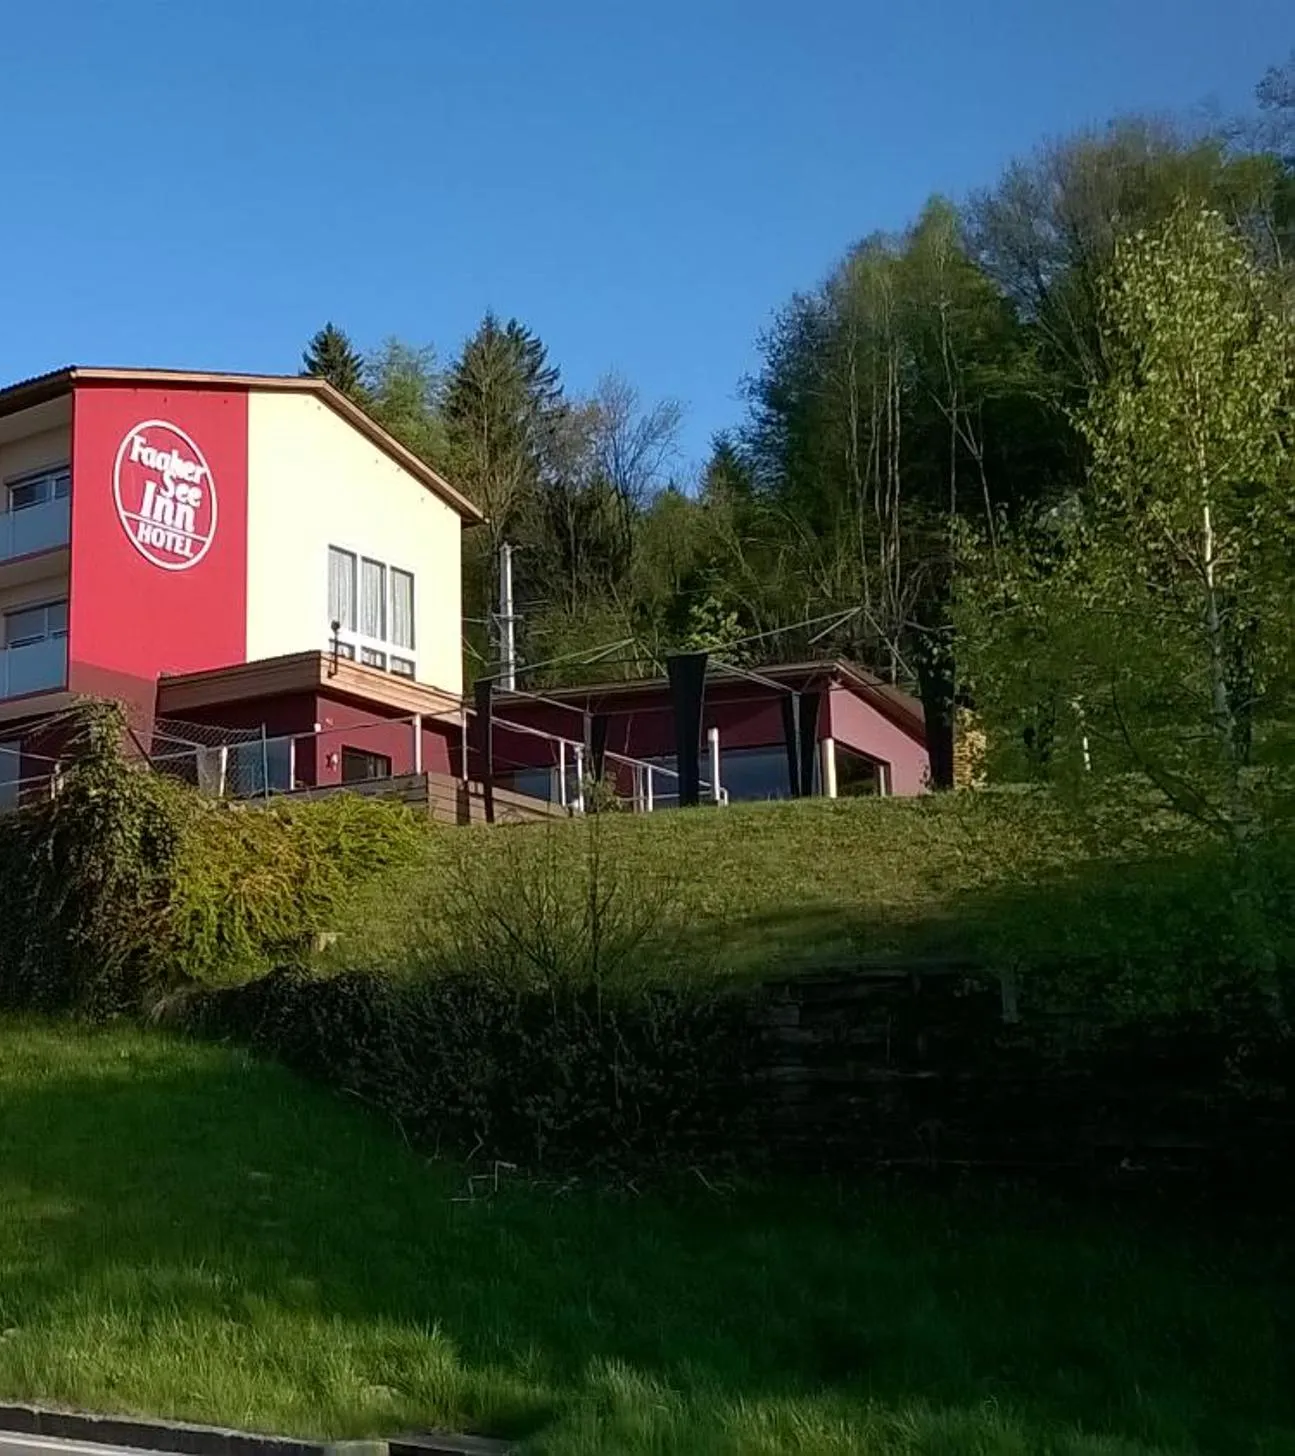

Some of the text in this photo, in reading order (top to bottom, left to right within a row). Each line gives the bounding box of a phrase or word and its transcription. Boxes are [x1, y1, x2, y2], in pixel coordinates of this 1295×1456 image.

[140, 480, 195, 532] Inn
[160, 471, 202, 507] See
[136, 522, 193, 557] HOTEL
